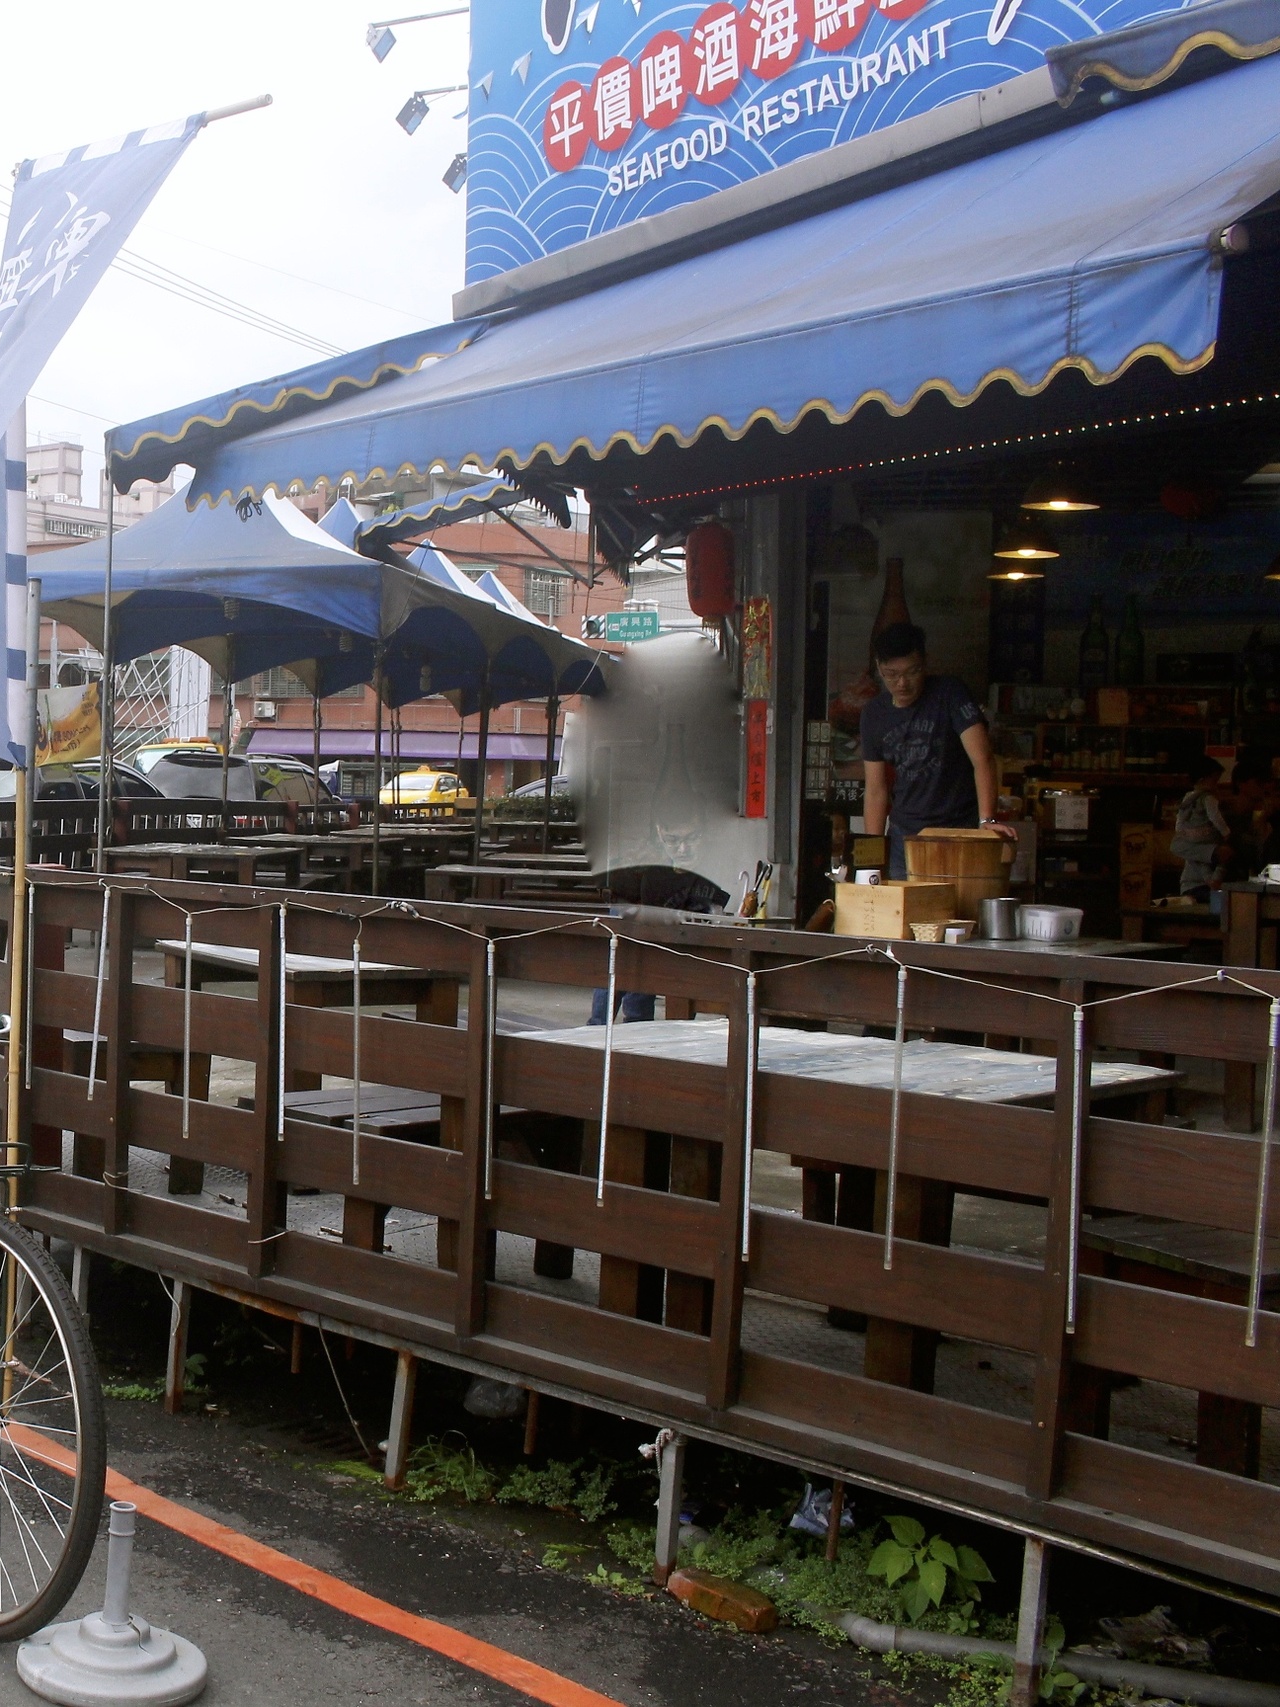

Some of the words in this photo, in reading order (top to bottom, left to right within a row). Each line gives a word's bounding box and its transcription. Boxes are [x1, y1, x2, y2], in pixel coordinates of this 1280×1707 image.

[548, 0, 926, 159] 平價啤酒海鮮
[608, 123, 728, 198] SEAFOOD
[742, 18, 952, 143] RESTAURANT
[620, 616, 652, 627] 廣興路
